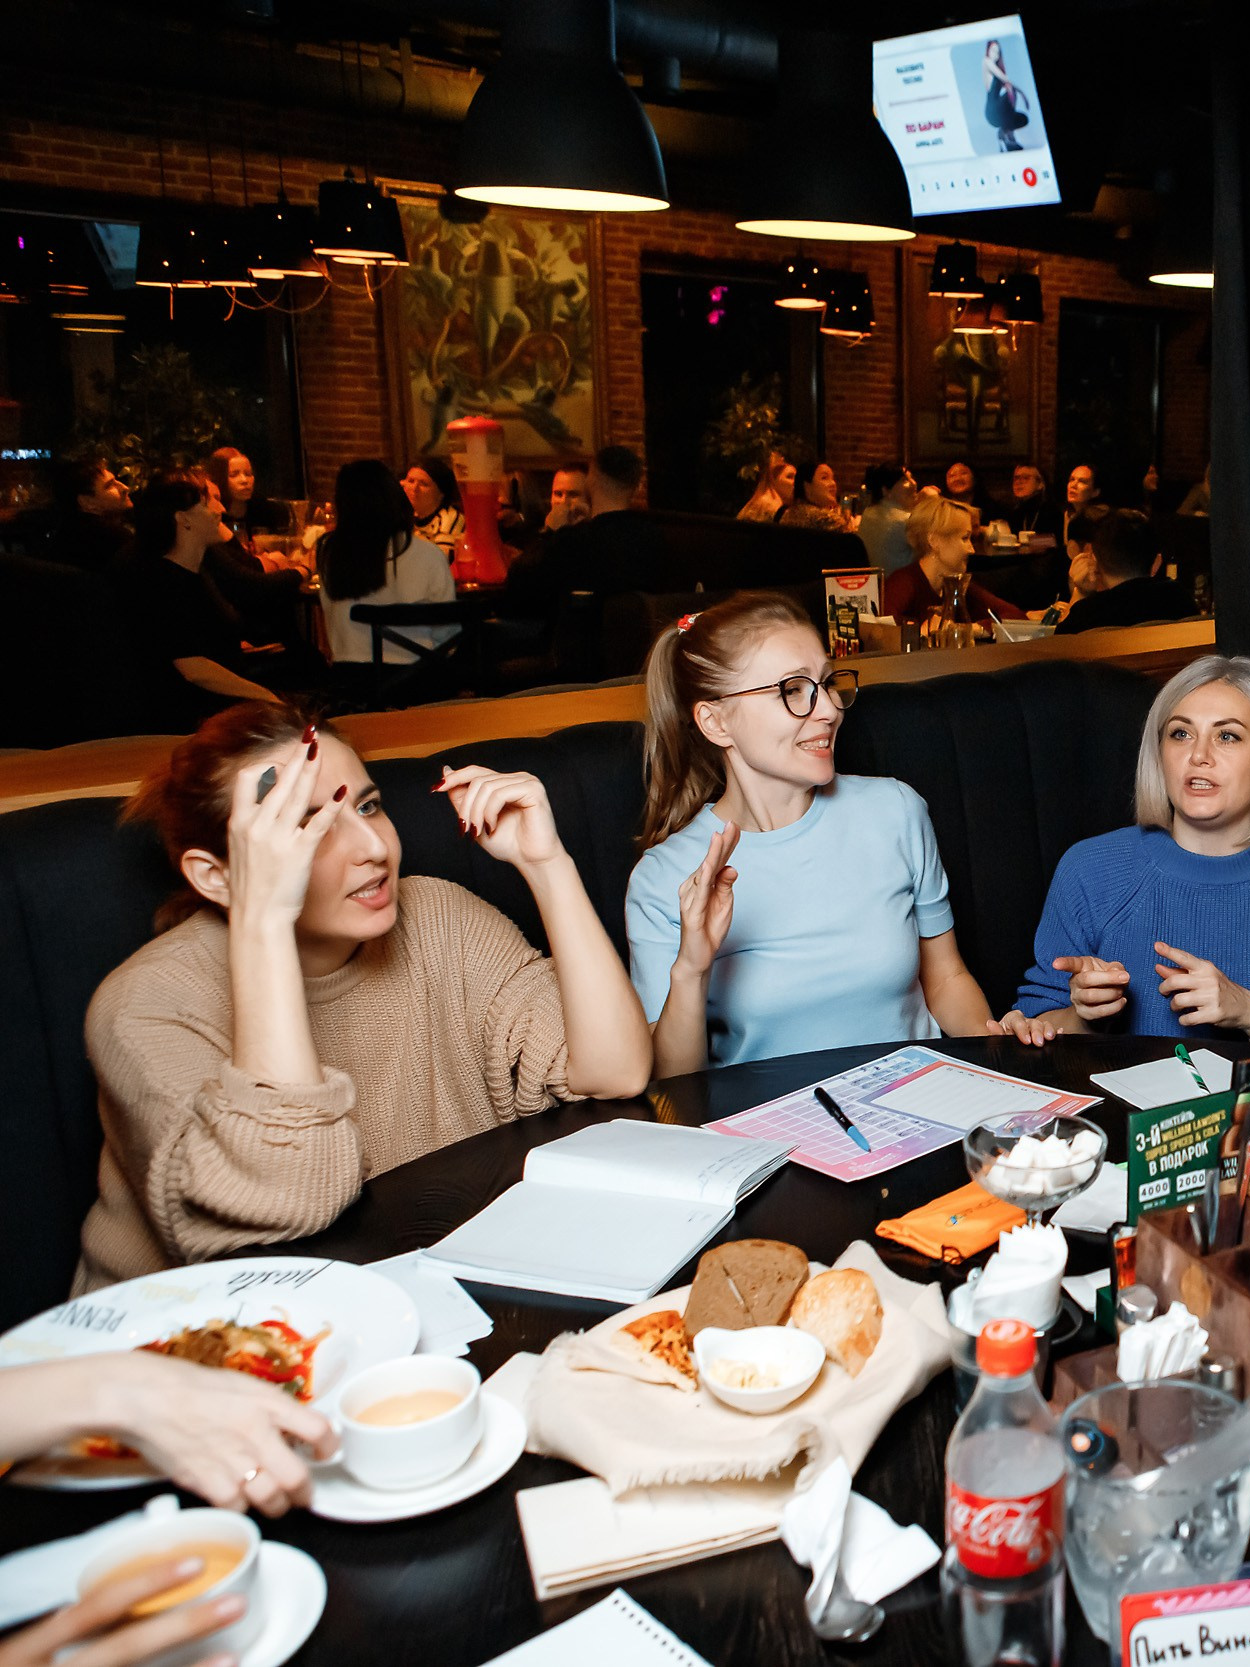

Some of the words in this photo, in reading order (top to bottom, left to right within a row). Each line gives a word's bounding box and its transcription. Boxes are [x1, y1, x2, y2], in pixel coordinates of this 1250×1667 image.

[1149, 1160, 1157, 1177] В
[1160, 1140, 1209, 1172] ПОДАРОК
[1141, 1182, 1169, 1197] 4000
[1178, 1173, 1205, 1189] 2000
[1134, 1635, 1192, 1667] Пить
